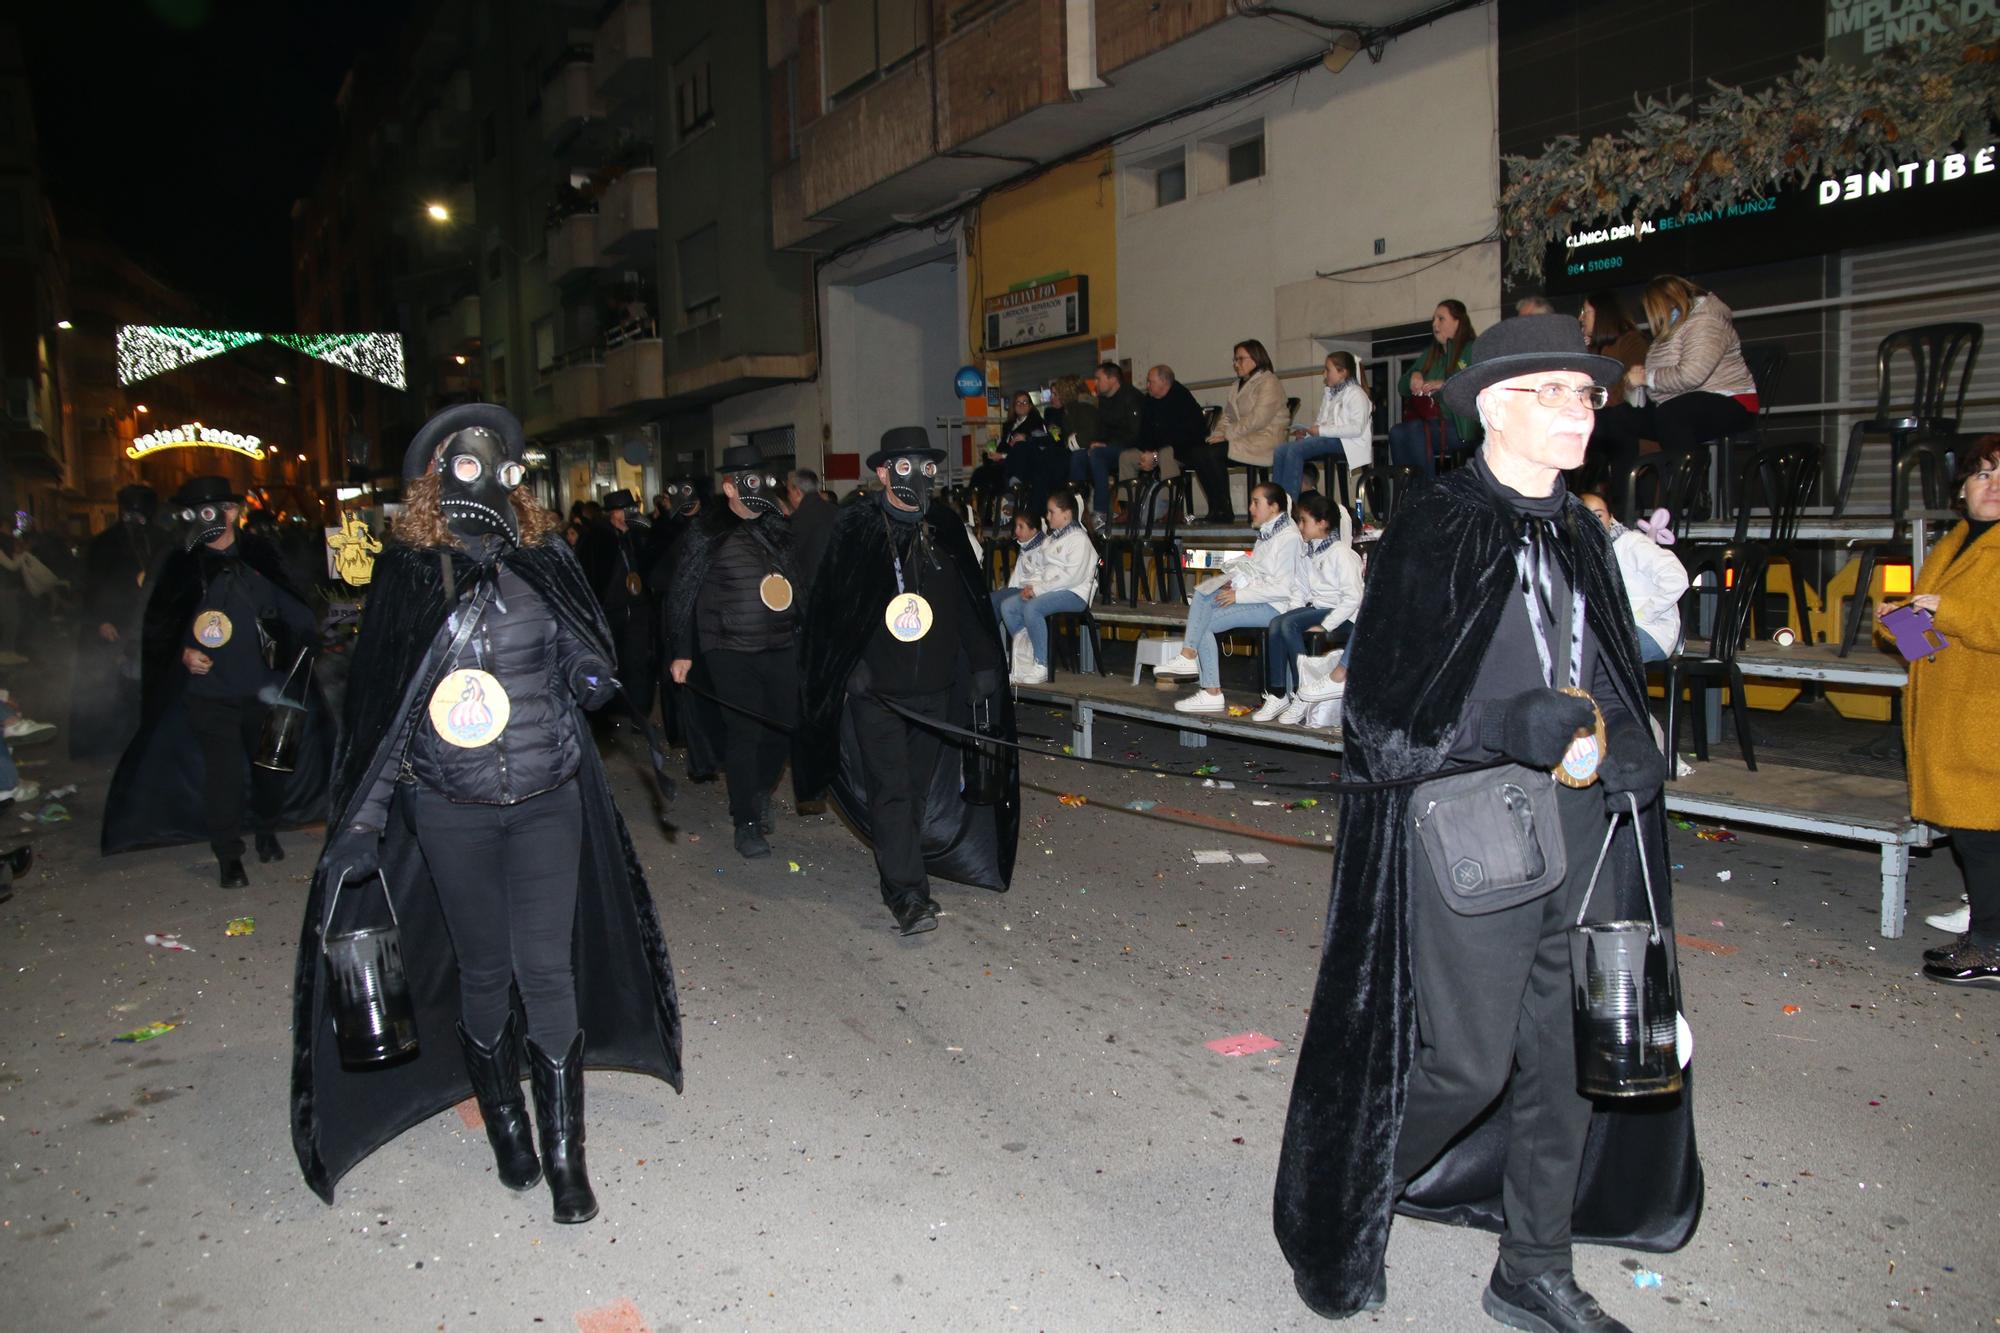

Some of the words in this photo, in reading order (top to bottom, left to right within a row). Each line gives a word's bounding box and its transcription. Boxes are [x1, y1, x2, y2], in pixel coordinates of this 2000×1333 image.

[1610, 220, 1657, 241] DENAL
[1567, 262, 1585, 276] 964
[1587, 256, 1623, 272] 510690
